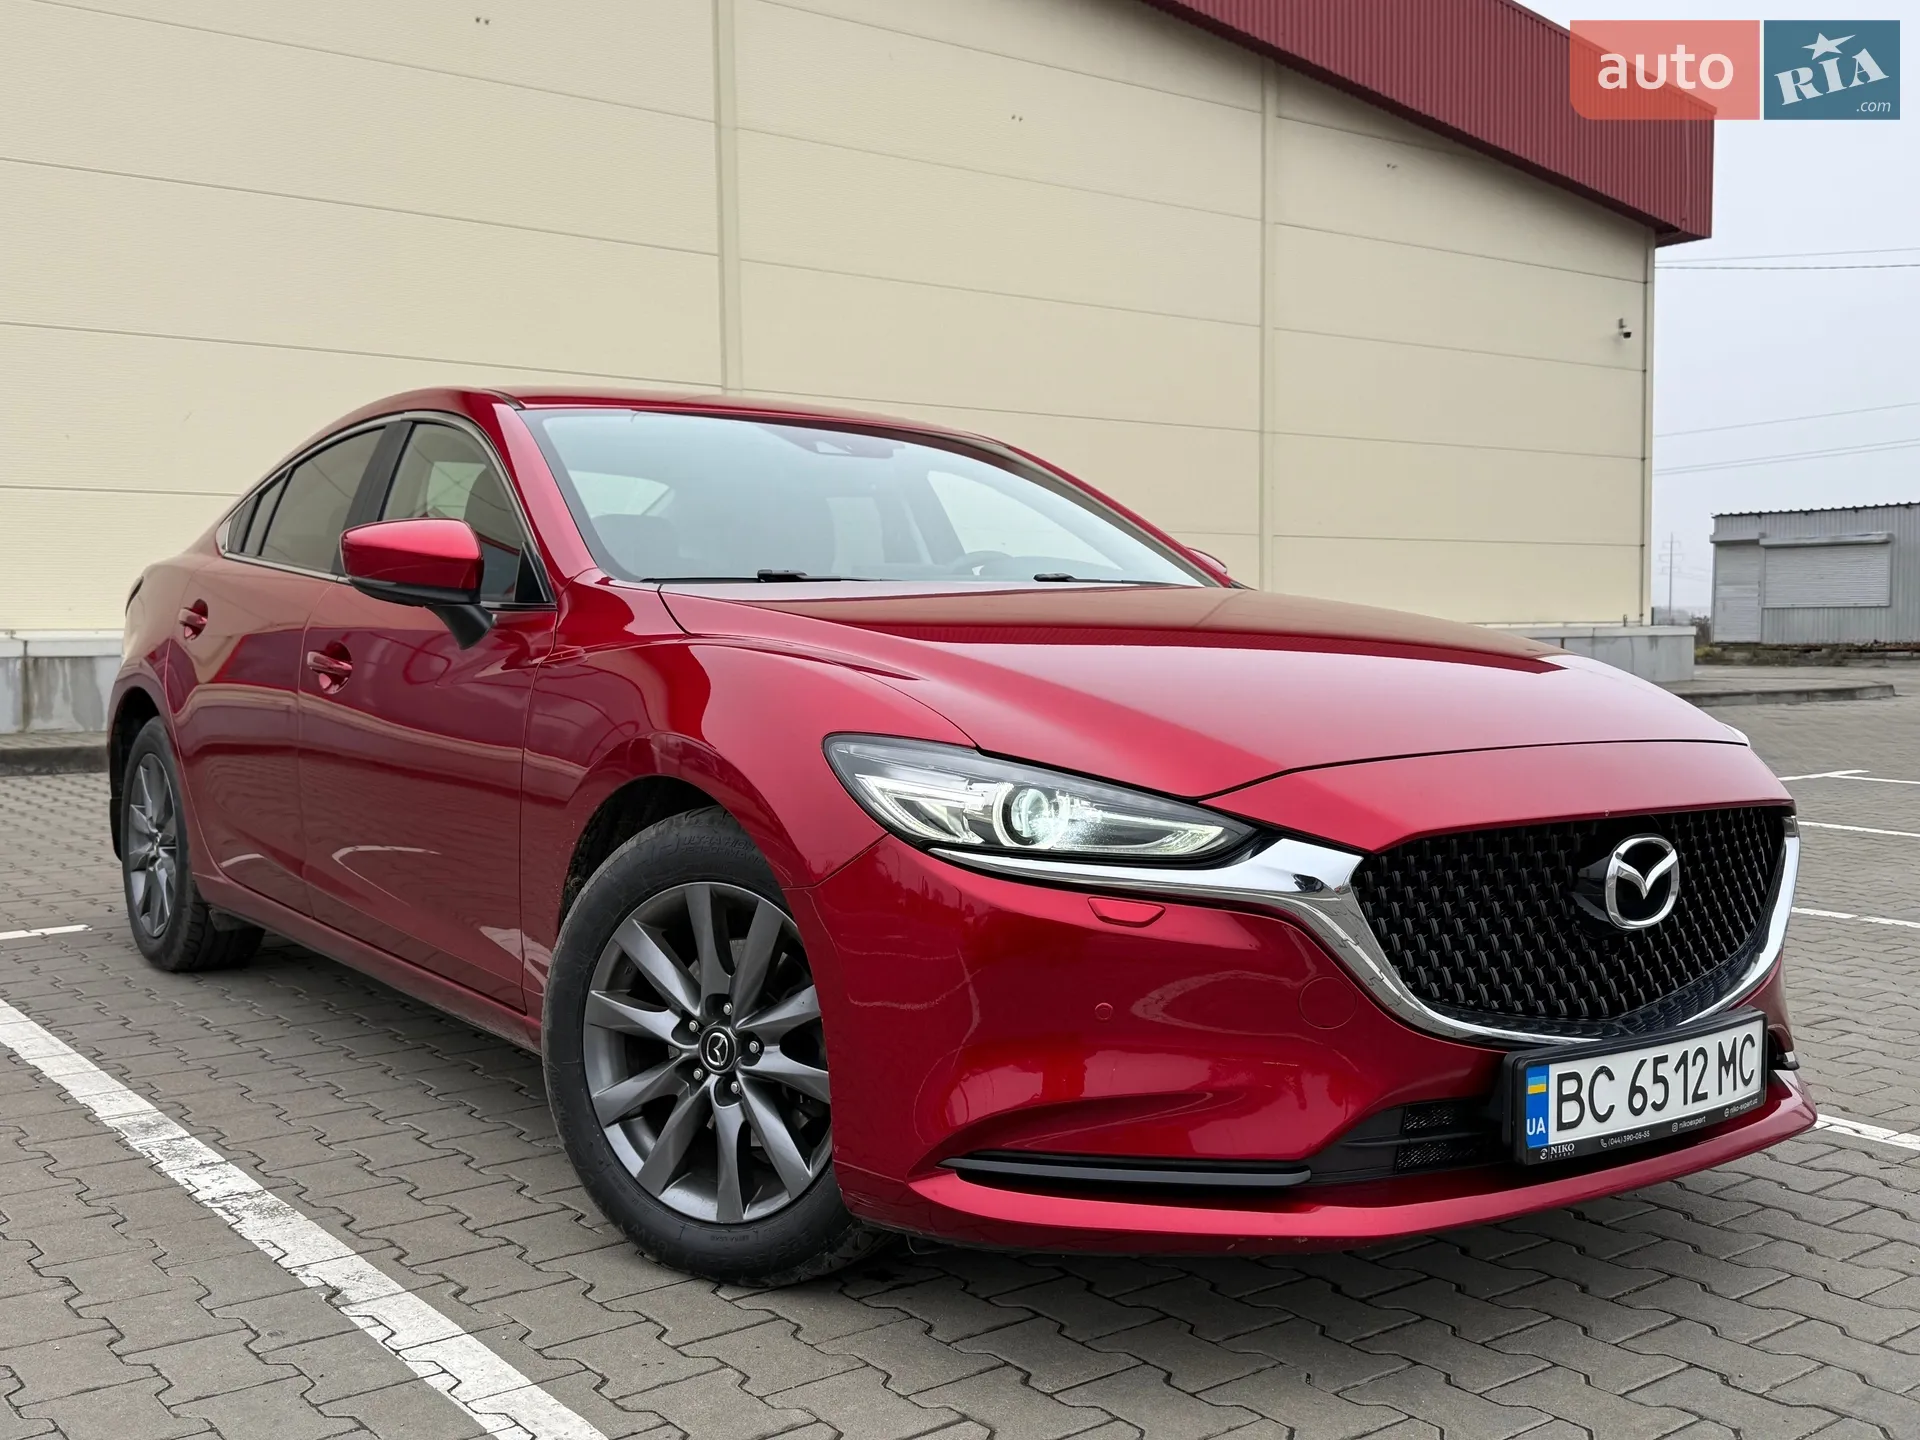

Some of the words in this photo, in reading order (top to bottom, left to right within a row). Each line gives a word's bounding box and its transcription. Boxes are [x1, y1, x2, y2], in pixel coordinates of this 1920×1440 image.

[1556, 1065, 1615, 1132] BC
[1627, 1046, 1709, 1117] 6512
[1717, 1033, 1756, 1096] MC
[1526, 1116, 1546, 1136] UA
[1550, 1143, 1575, 1155] NIKO
